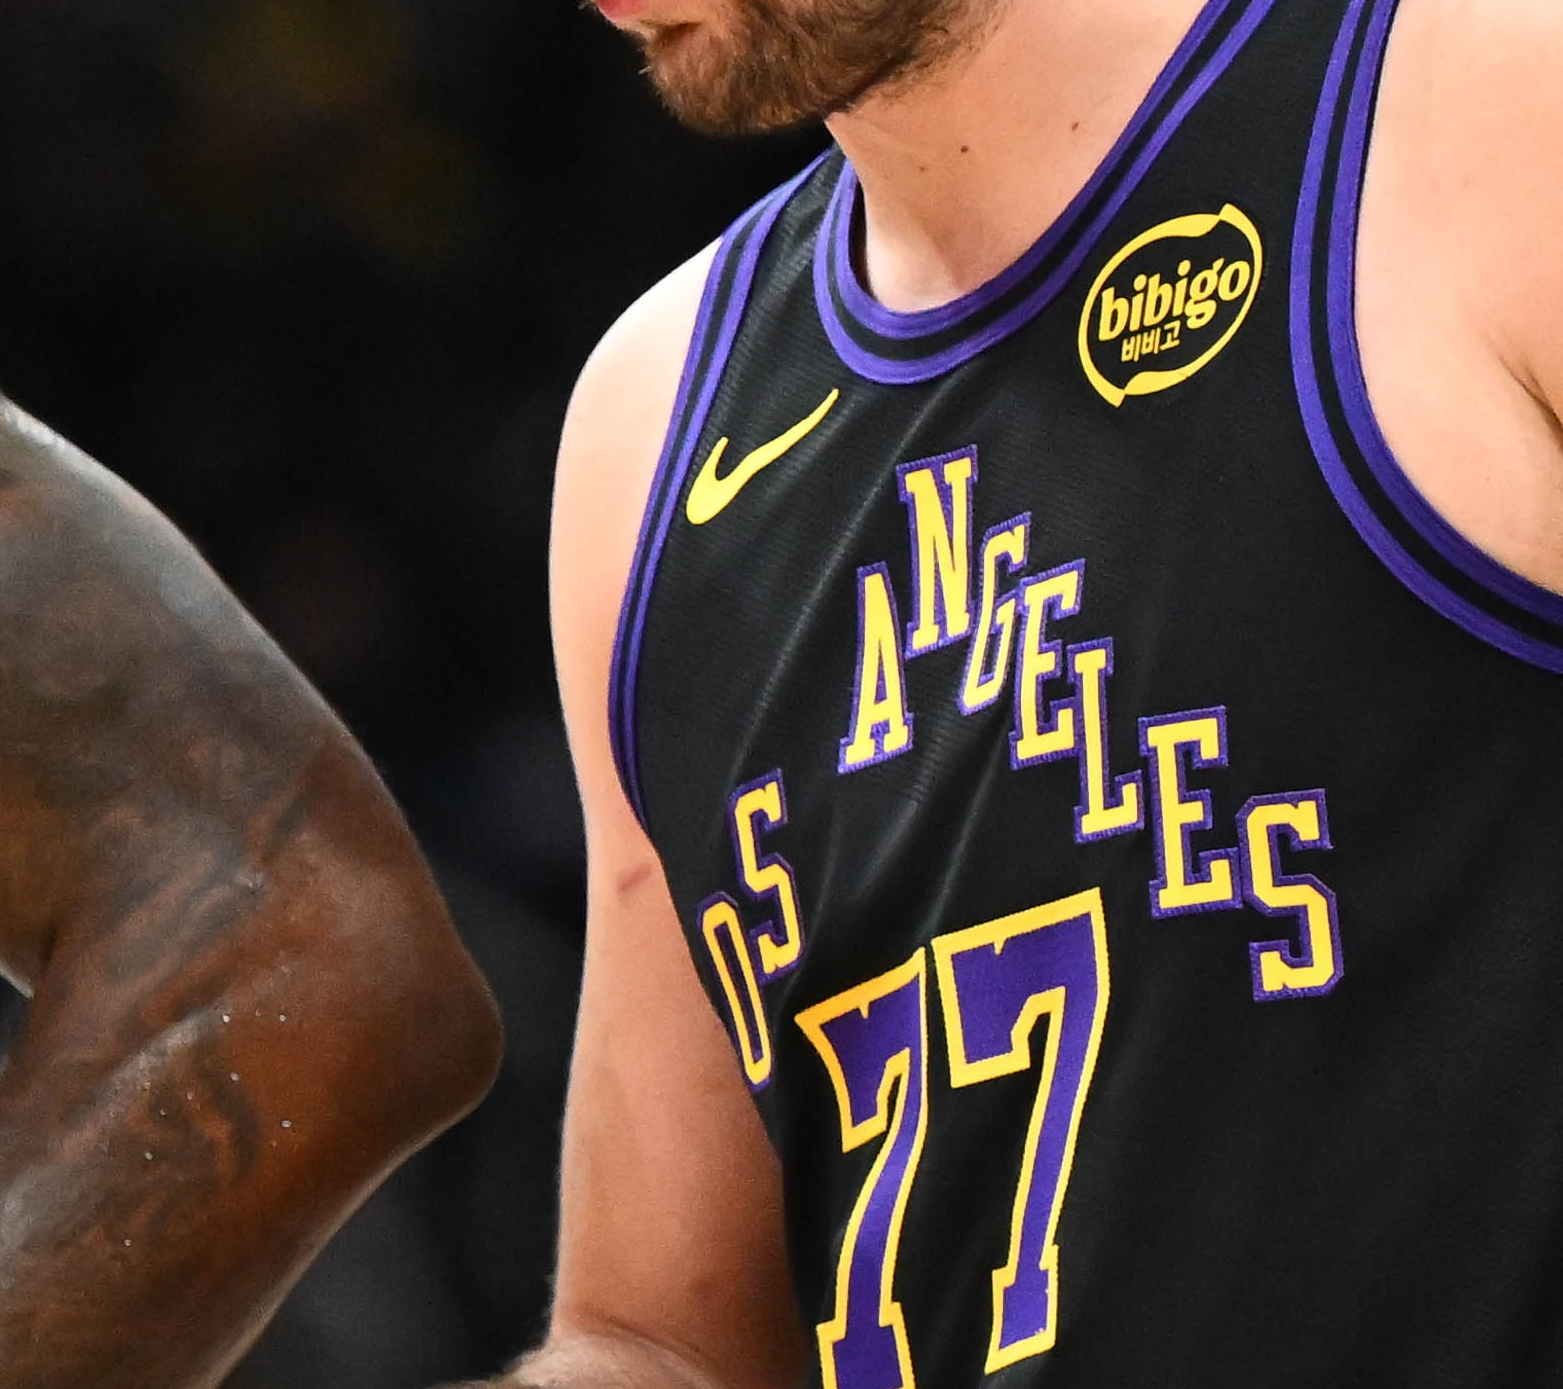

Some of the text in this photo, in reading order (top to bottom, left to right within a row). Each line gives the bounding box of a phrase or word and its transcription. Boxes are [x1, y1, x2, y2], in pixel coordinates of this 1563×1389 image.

[1098, 257, 1251, 341] bibigo
[1120, 320, 1181, 363] 비비고
[696, 443, 1345, 1092] OS ANGELES
